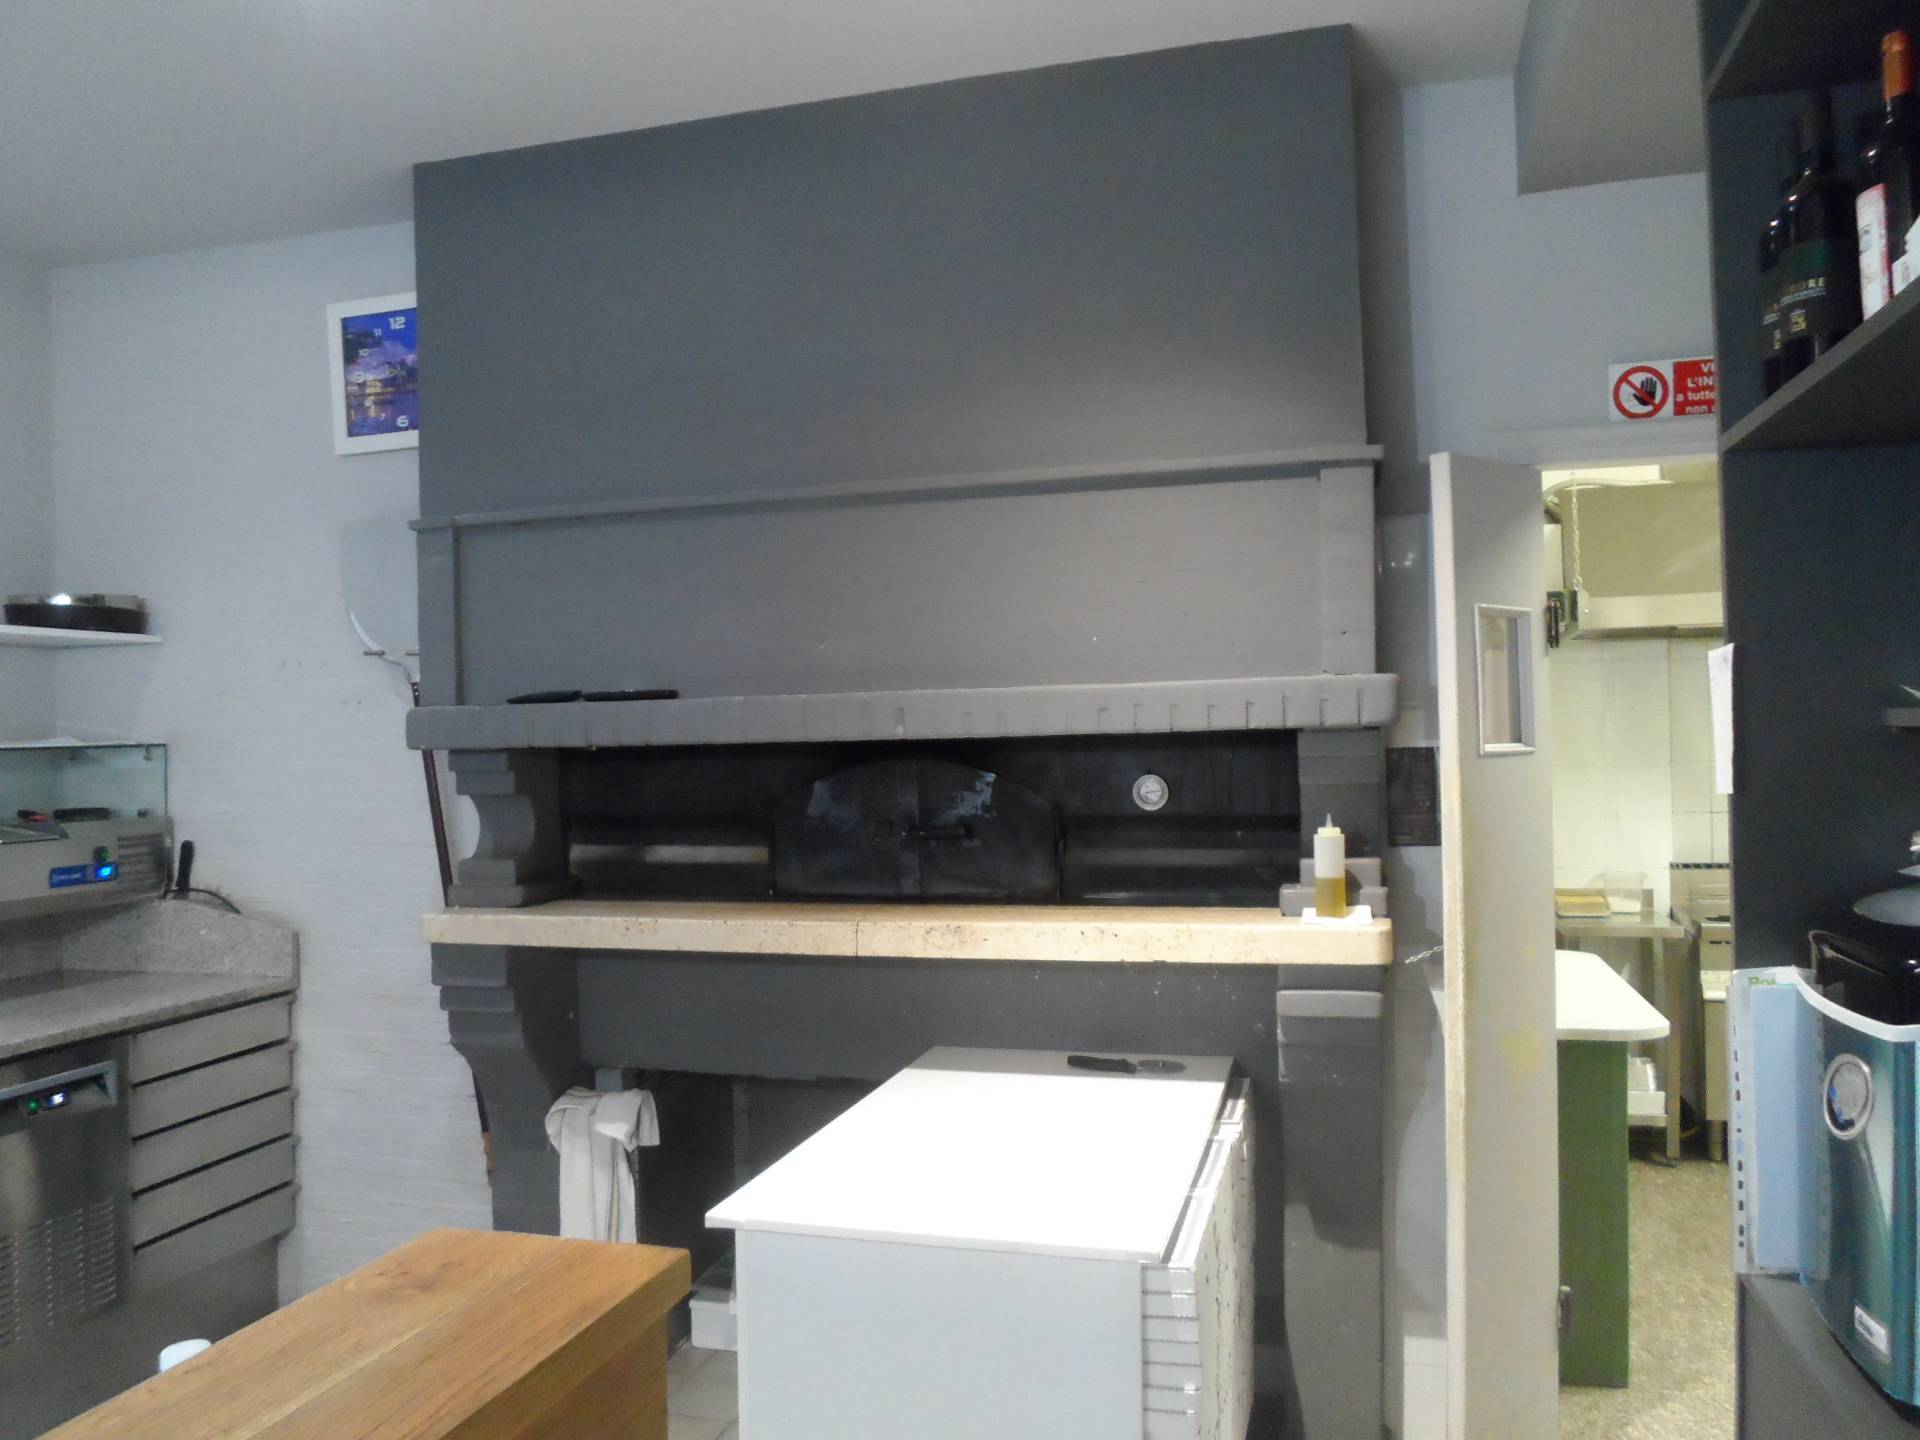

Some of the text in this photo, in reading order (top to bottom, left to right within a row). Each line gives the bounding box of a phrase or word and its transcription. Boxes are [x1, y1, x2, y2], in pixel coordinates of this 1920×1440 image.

[389, 316, 405, 329] 12
[374, 328, 382, 336] 11
[358, 348, 370, 357] 10
[353, 371, 364, 383] 9
[1677, 393, 1684, 402] a
[380, 413, 386, 421] 7
[396, 415, 409, 428] 6
